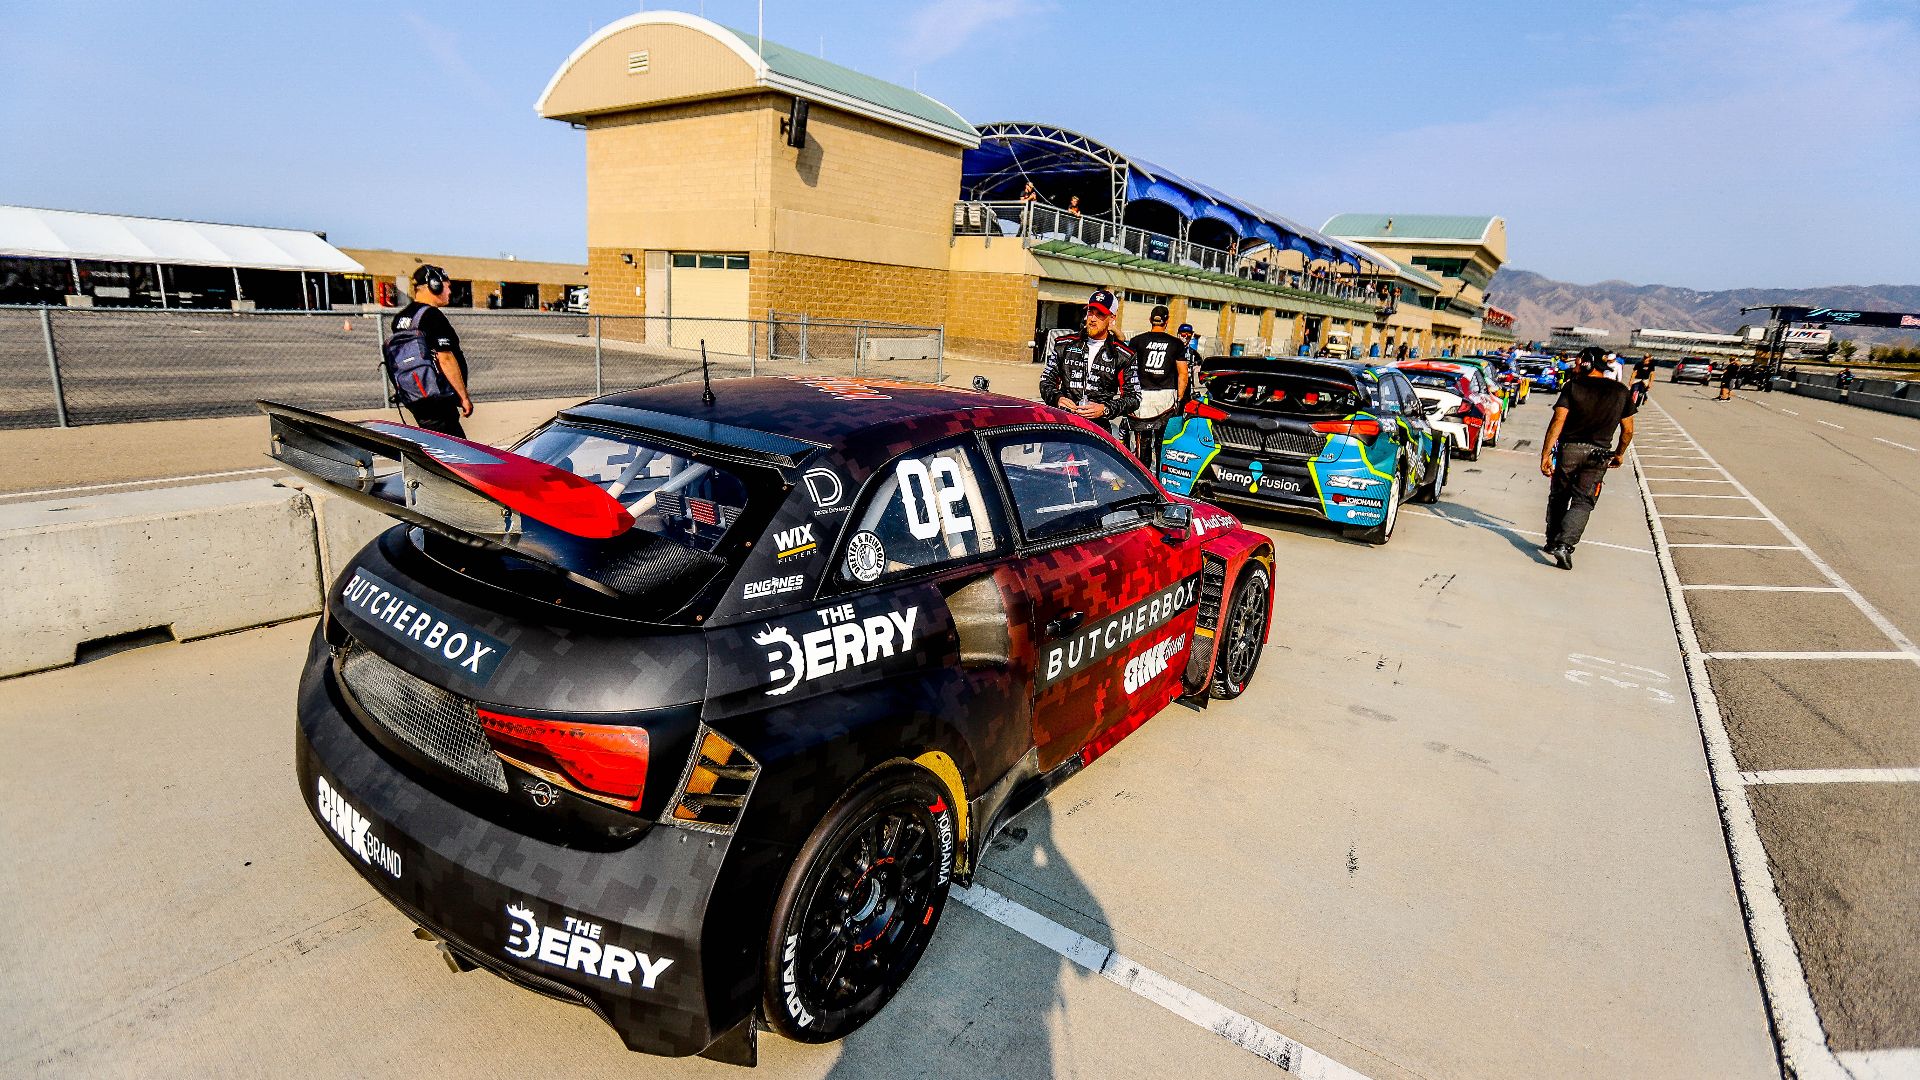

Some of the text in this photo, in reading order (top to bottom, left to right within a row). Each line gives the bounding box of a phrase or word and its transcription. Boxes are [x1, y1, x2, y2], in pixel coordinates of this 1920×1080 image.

[1145, 341, 1169, 351] ARPIN
[1145, 350, 1167, 369] 00
[1216, 468, 1300, 492] Hemp Fusion
[896, 456, 974, 541] 02
[1345, 496, 1382, 508] YOKOHAMA
[773, 523, 816, 552] WIX
[1202, 513, 1237, 530] Audi Sport
[778, 548, 817, 565] FILTERS
[849, 541, 861, 575] DREYER
[864, 533, 884, 569] REINBOLD
[342, 574, 493, 674] BUTCHERBOX
[816, 603, 856, 626] THE
[1046, 579, 1196, 681] BUTCHERBOX
[752, 606, 918, 696] BERRY
[318, 775, 401, 879] OINK BRAND
[937, 809, 951, 887] YOKOHAMA
[504, 901, 675, 989] BERRY
[564, 916, 602, 940] THE
[783, 933, 815, 1028] ADVAN
